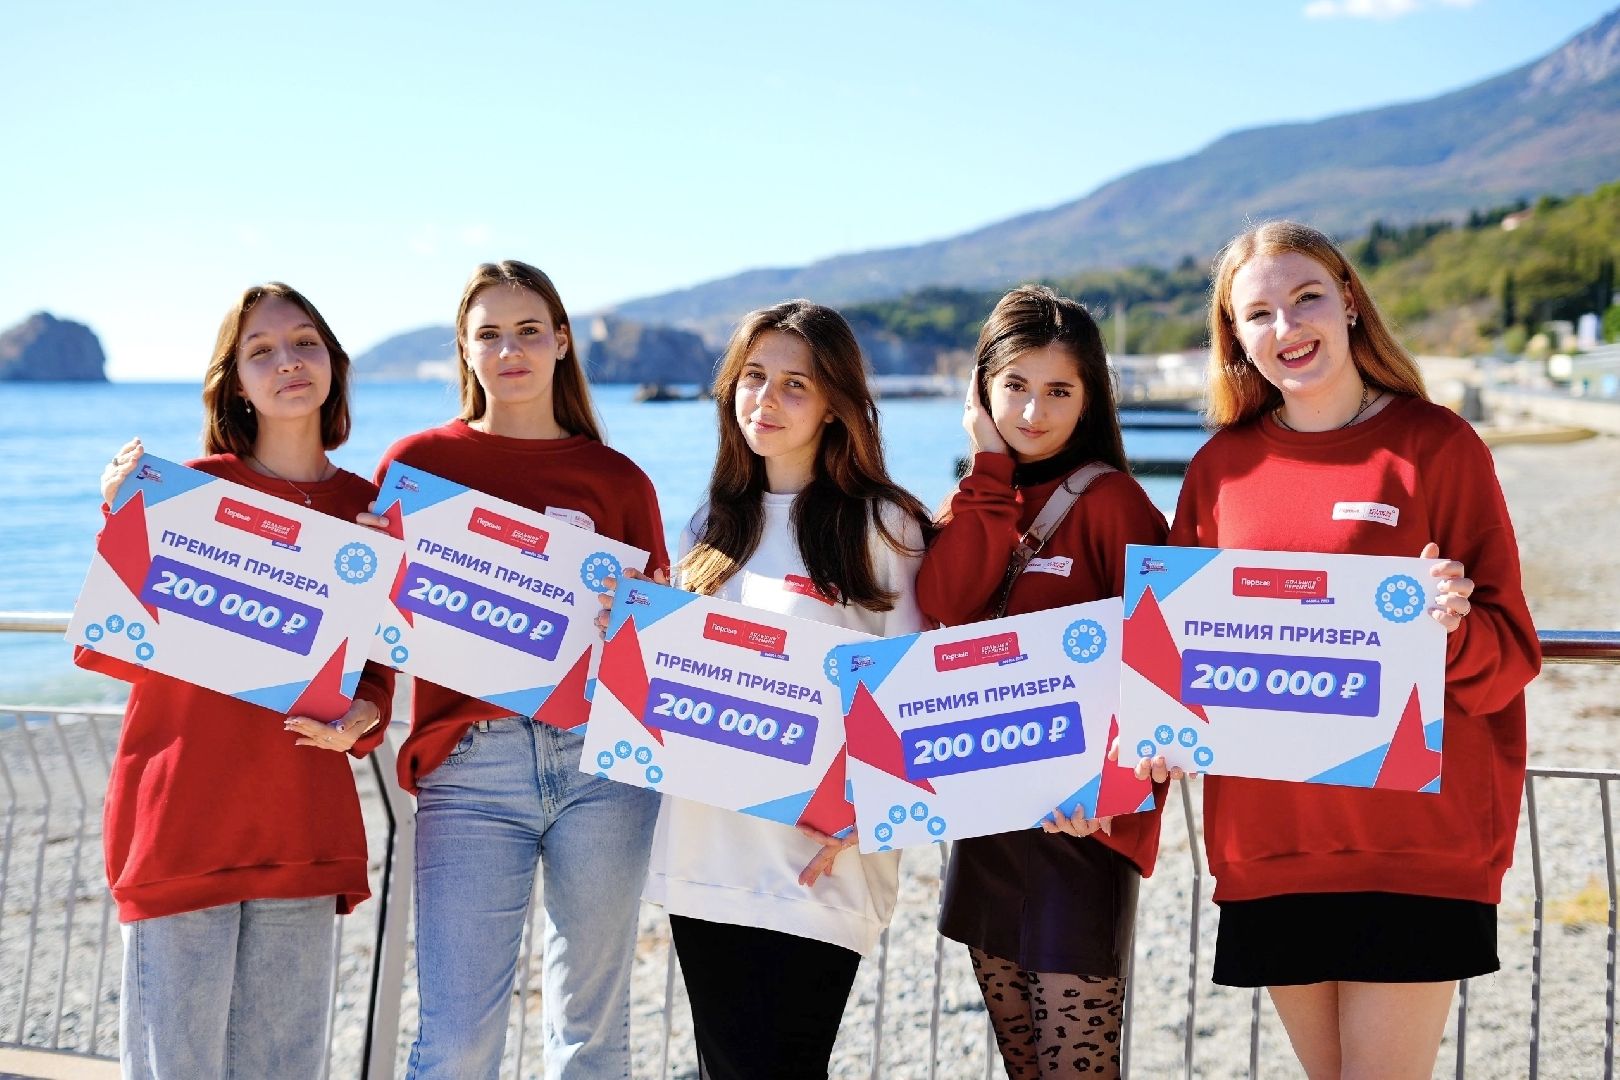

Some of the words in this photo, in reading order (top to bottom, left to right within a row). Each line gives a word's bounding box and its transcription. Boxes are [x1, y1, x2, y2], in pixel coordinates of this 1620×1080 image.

[161, 530, 241, 568] ПРЕМИЯ
[243, 558, 329, 598] ПРИЗЕРА
[416, 538, 492, 576] ПРЕМИЯ
[494, 566, 575, 606] ПРИЗЕРА
[1241, 577, 1271, 587] Первые
[152, 570, 217, 607] 200
[219, 593, 282, 629] 000
[407, 577, 468, 612] 200
[471, 600, 530, 634] 000
[1184, 620, 1274, 641] ПРЕМИЯ
[1279, 625, 1381, 647] ПРИЗЕРА
[655, 651, 733, 683] ПРЕМИЯ
[736, 671, 823, 705] ПРИЗЕРА
[898, 691, 979, 718] ПРЕМИЯ
[984, 675, 1076, 703] ПРИЗЕРА
[1190, 663, 1260, 693] 200
[1266, 668, 1337, 698] 000
[653, 693, 715, 725] 200
[718, 708, 779, 741] 000
[913, 732, 976, 765] 200
[981, 721, 1044, 753] 000
